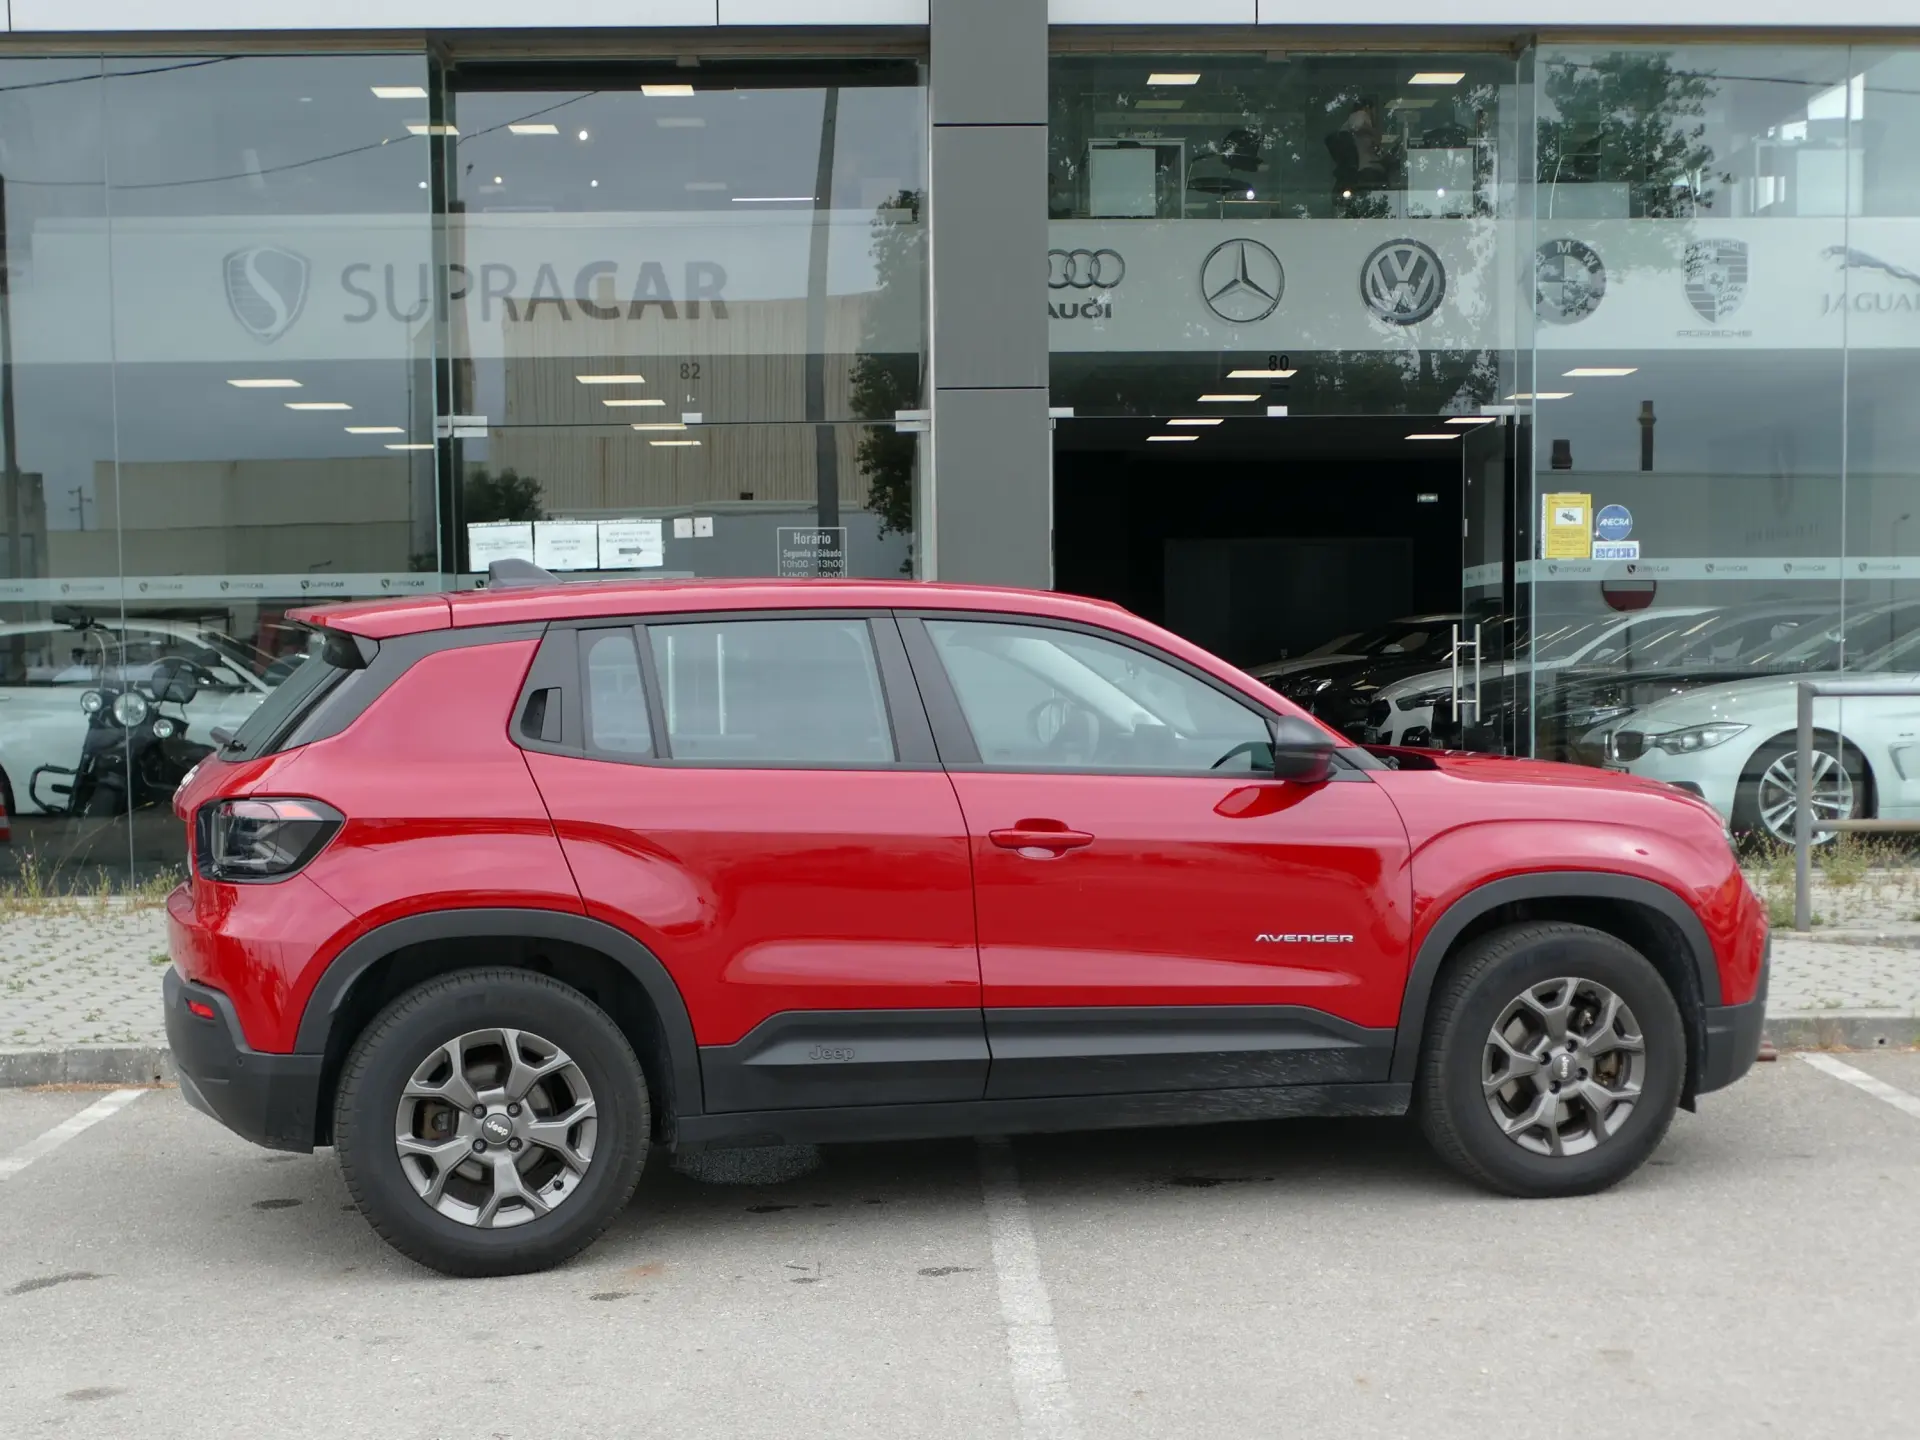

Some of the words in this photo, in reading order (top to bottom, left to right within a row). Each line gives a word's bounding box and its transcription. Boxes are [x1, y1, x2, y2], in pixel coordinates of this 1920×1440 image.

[341, 261, 730, 324] SUPRACAR
[1676, 329, 1753, 338] PORSCHE
[1268, 354, 1290, 371] 80
[679, 362, 701, 380] 82
[793, 531, 832, 545] Horário
[783, 549, 811, 559] Segunda
[782, 560, 809, 568] 10h00
[818, 560, 844, 568] 13h00
[1255, 934, 1354, 943] AVENGER
[809, 1044, 856, 1061] Jeep
[486, 1120, 508, 1136] Jeep
